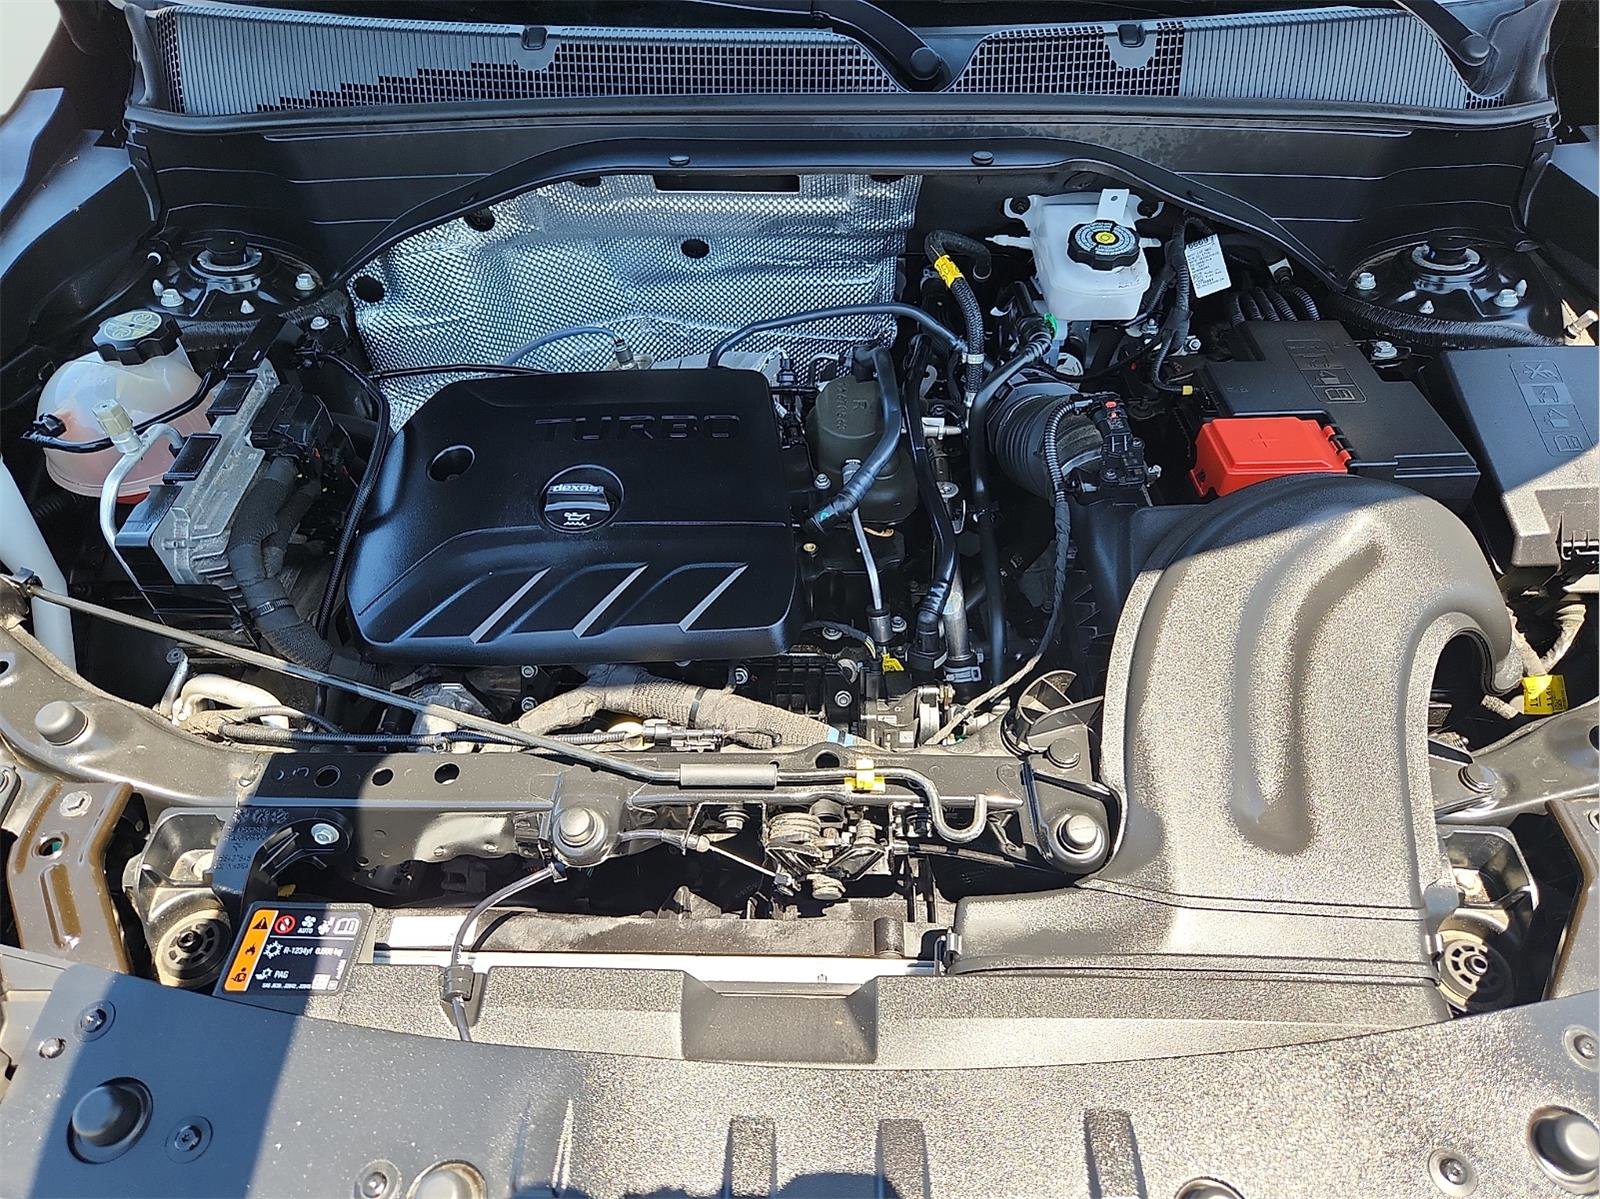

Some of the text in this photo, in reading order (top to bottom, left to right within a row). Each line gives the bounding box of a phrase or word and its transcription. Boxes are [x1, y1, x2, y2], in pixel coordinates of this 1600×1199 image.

[535, 415, 741, 441] TURBO
[552, 483, 600, 493] dexos
[297, 927, 314, 935] AUTO
[283, 946, 313, 956] R-1234yf
[273, 970, 290, 979] PAG
